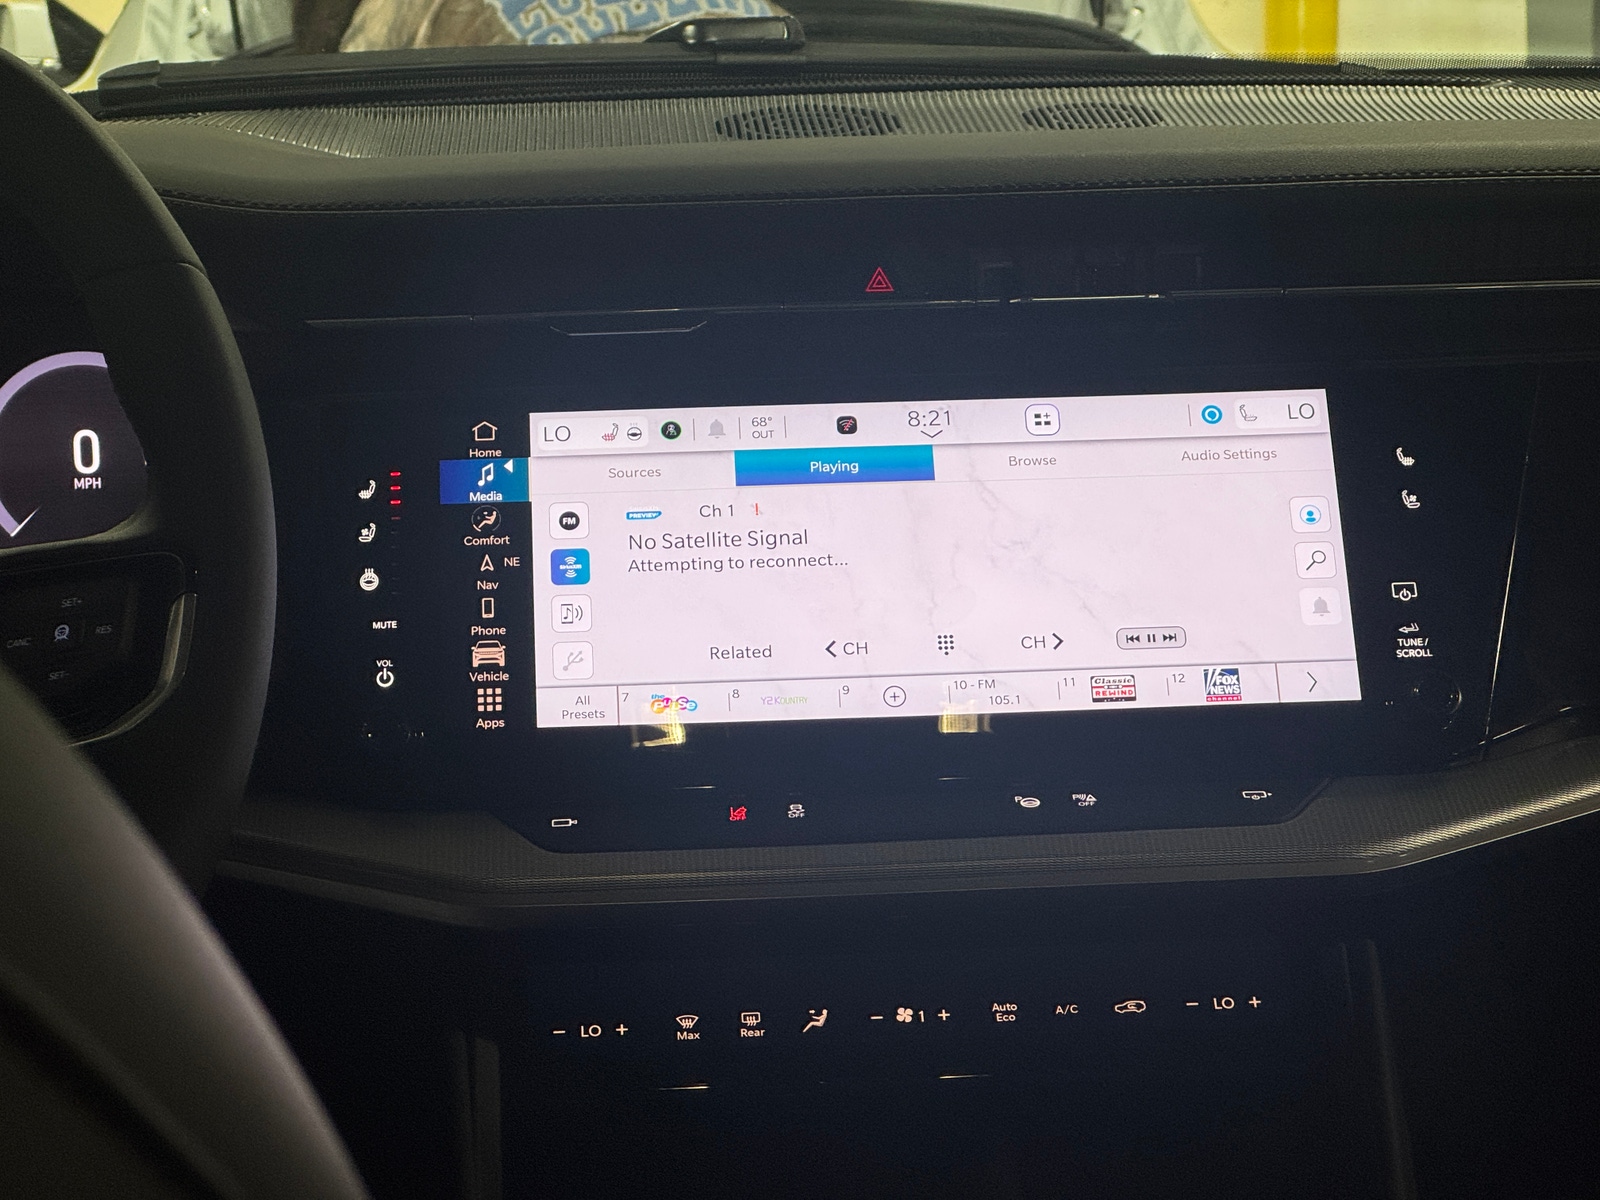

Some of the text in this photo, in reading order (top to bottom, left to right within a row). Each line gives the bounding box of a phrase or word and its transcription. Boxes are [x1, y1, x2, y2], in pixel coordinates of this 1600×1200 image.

[1287, 402, 1316, 421] LO
[751, 416, 773, 428] 68°
[907, 409, 952, 428] 8:21
[543, 425, 571, 442] LO
[752, 429, 774, 440] OUT
[72, 429, 101, 475] 0
[469, 448, 502, 457] Home
[1181, 447, 1278, 463] Audio Settings
[809, 459, 859, 474] Playing
[1008, 455, 1057, 467] Browse
[608, 466, 662, 479] Sources
[73, 477, 102, 490] MPH
[469, 491, 503, 502] Media
[699, 504, 735, 519] Ch 1
[562, 516, 576, 526] FM
[464, 535, 510, 546] Comfort
[628, 529, 808, 551] No Satellite Signal
[504, 556, 521, 567] NE
[628, 553, 849, 574] Attempting to reconnect...
[477, 580, 499, 590] Nav
[372, 620, 398, 629] MUTE
[471, 625, 507, 636] Phone
[1021, 635, 1046, 649] CH
[709, 644, 773, 660] Related
[843, 641, 869, 656] CH
[1396, 648, 1433, 658] SCROLL
[469, 671, 509, 682] Vehicle
[1063, 677, 1076, 687] 11
[1094, 677, 1133, 685] Classic
[1172, 673, 1185, 683] 12
[1217, 675, 1239, 686] FOX
[953, 680, 968, 690] 10
[977, 679, 996, 690] FM
[1210, 685, 1240, 695] NEWS
[732, 689, 740, 699] 8
[842, 685, 850, 696] 9
[1095, 689, 1134, 697] REWIND
[575, 694, 591, 706] All
[622, 692, 629, 702] 7
[988, 694, 1021, 706] 105.1
[561, 707, 606, 721] Presets
[475, 718, 505, 729] Apps
[991, 1002, 1018, 1013] Auto
[1055, 1004, 1079, 1015] A/C
[1213, 997, 1235, 1011] LO
[918, 1010, 925, 1023] 1
[996, 1012, 1016, 1022] Eco
[581, 1025, 602, 1038] LO
[676, 1030, 700, 1041] Max
[740, 1027, 765, 1038] Rear
